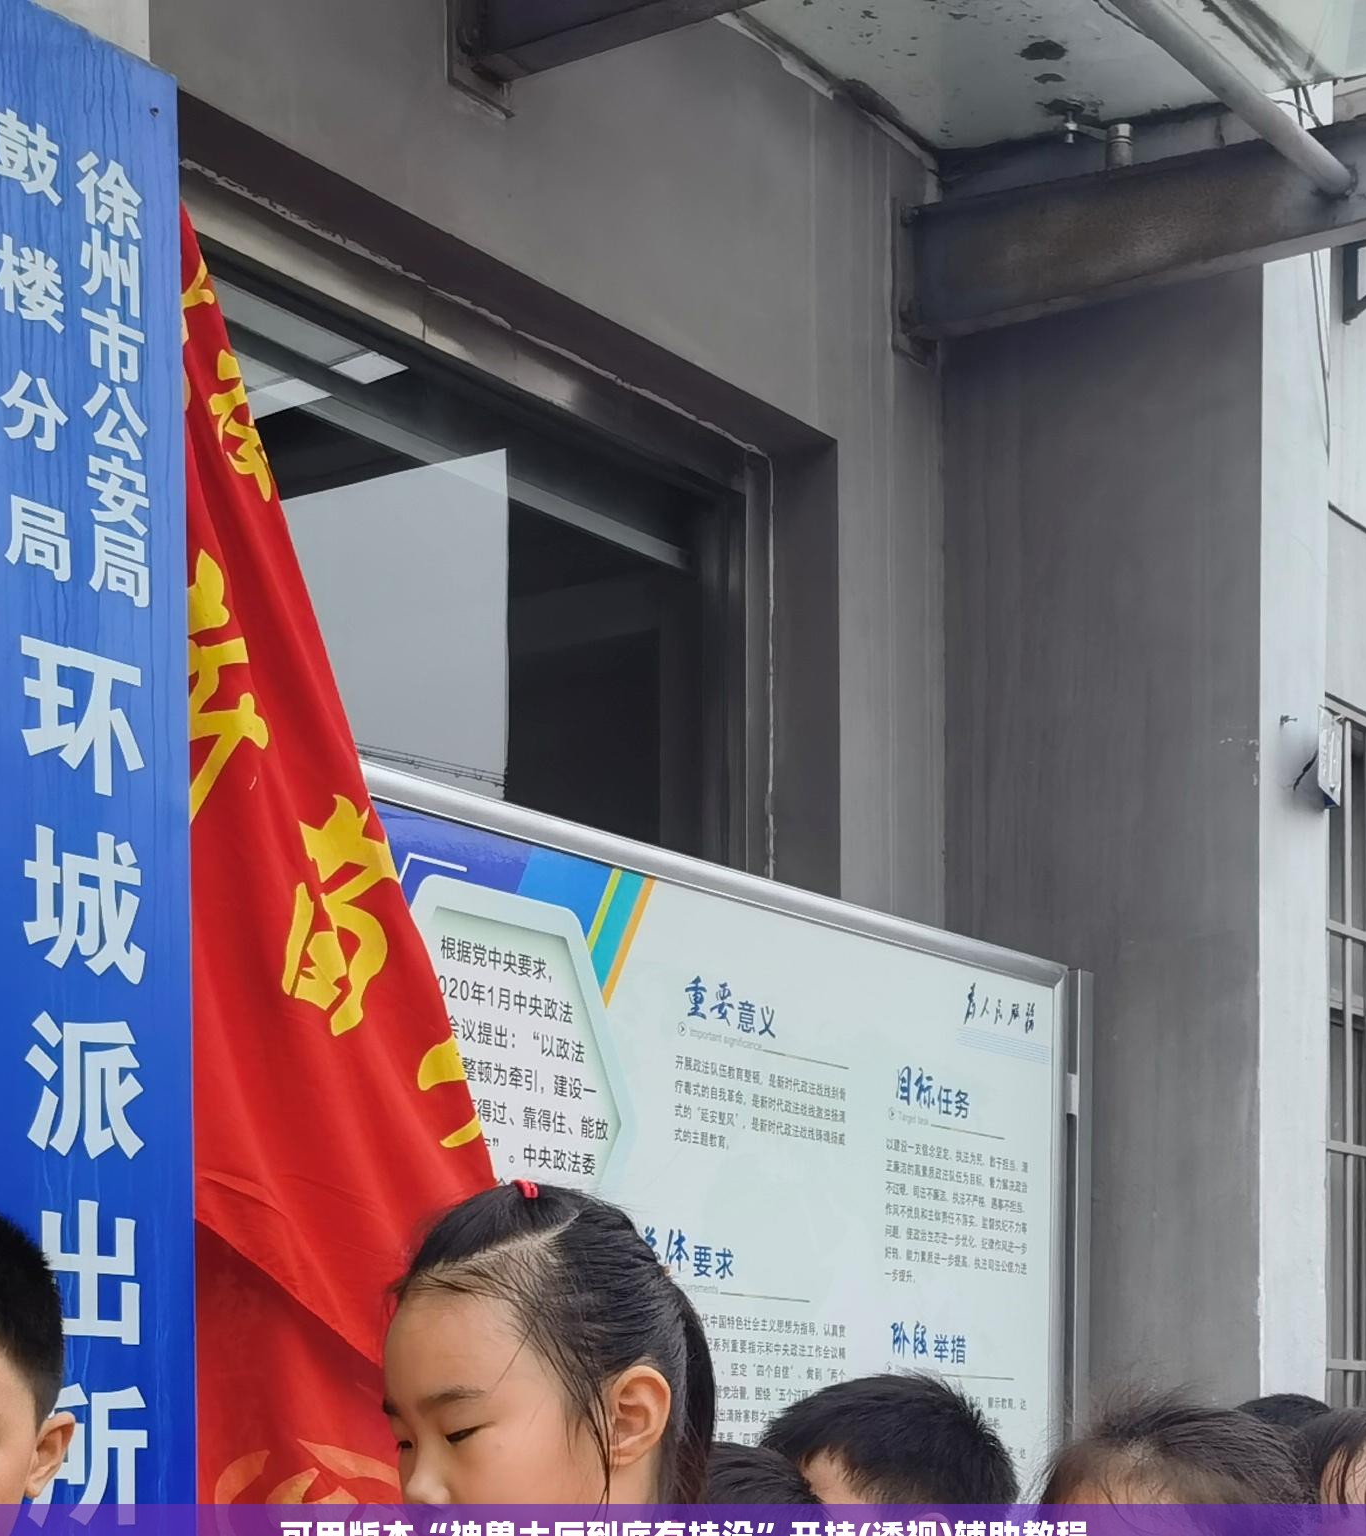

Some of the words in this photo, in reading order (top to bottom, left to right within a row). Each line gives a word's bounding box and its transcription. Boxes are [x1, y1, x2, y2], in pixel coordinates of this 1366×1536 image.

[76, 149, 150, 608] 徐州市公安局
[685, 975, 776, 1039] 重要意义
[20, 634, 148, 1528] 环城派出所
[896, 1065, 970, 1119] 目标任务
[890, 1320, 967, 1365] 阶段举措
